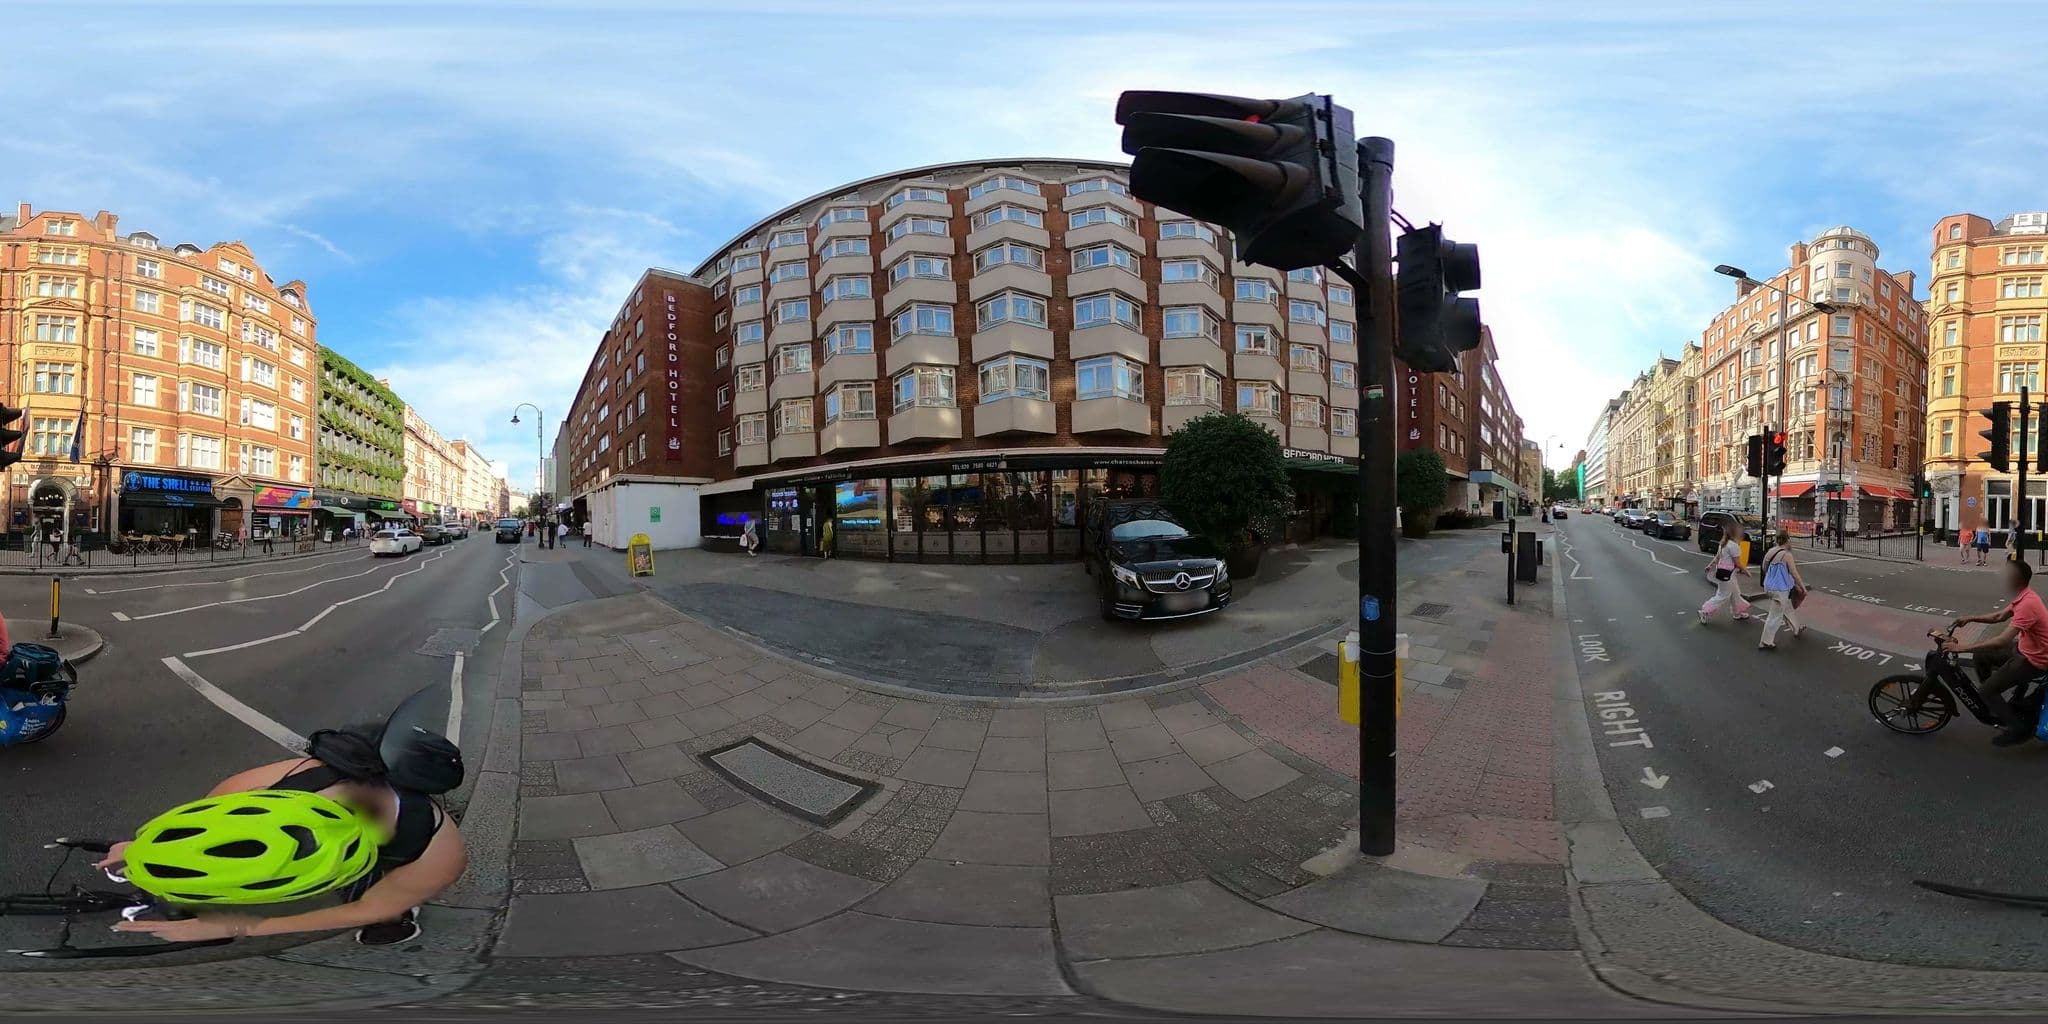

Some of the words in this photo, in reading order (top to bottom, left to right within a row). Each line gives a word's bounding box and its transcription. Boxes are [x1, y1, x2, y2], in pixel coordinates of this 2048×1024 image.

[667, 295, 677, 362] BEDFORD
[669, 369, 679, 427] HOTEL
[1408, 367, 1418, 419] OTEL
[142, 476, 160, 489] THE
[162, 478, 189, 491] SHELL
[189, 485, 211, 493] SEAFOOD
[1842, 592, 1886, 604] LOOK
[1904, 604, 1957, 616] LEFT
[1577, 634, 1611, 662] LOOK
[1827, 641, 1894, 666] LOOK
[1593, 690, 1654, 749] RIGHT
